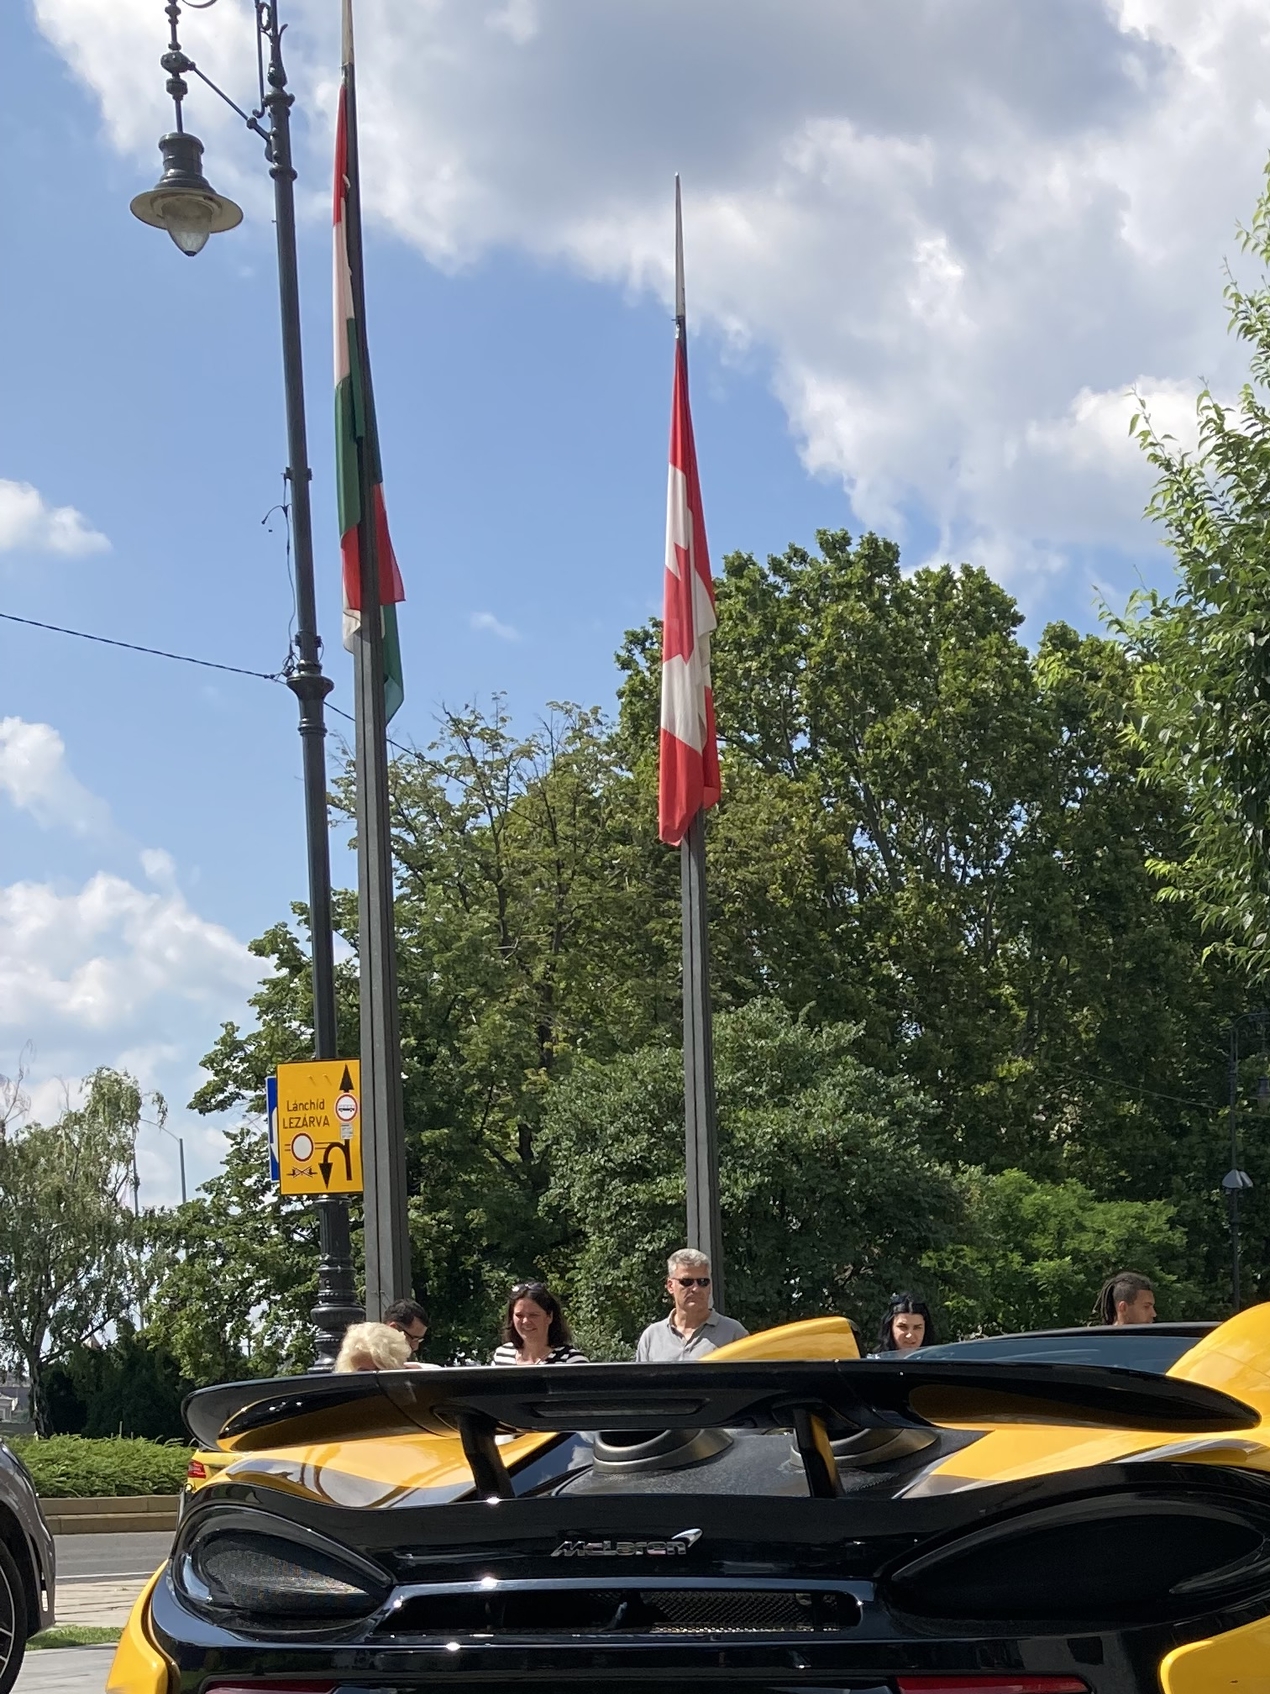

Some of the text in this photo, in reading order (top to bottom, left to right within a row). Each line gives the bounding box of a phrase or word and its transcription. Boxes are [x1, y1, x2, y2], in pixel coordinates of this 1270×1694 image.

[286, 1098, 325, 1112] Lánchíd
[282, 1113, 330, 1129] LEZÁRVA
[550, 1540, 687, 1557] McLaren
